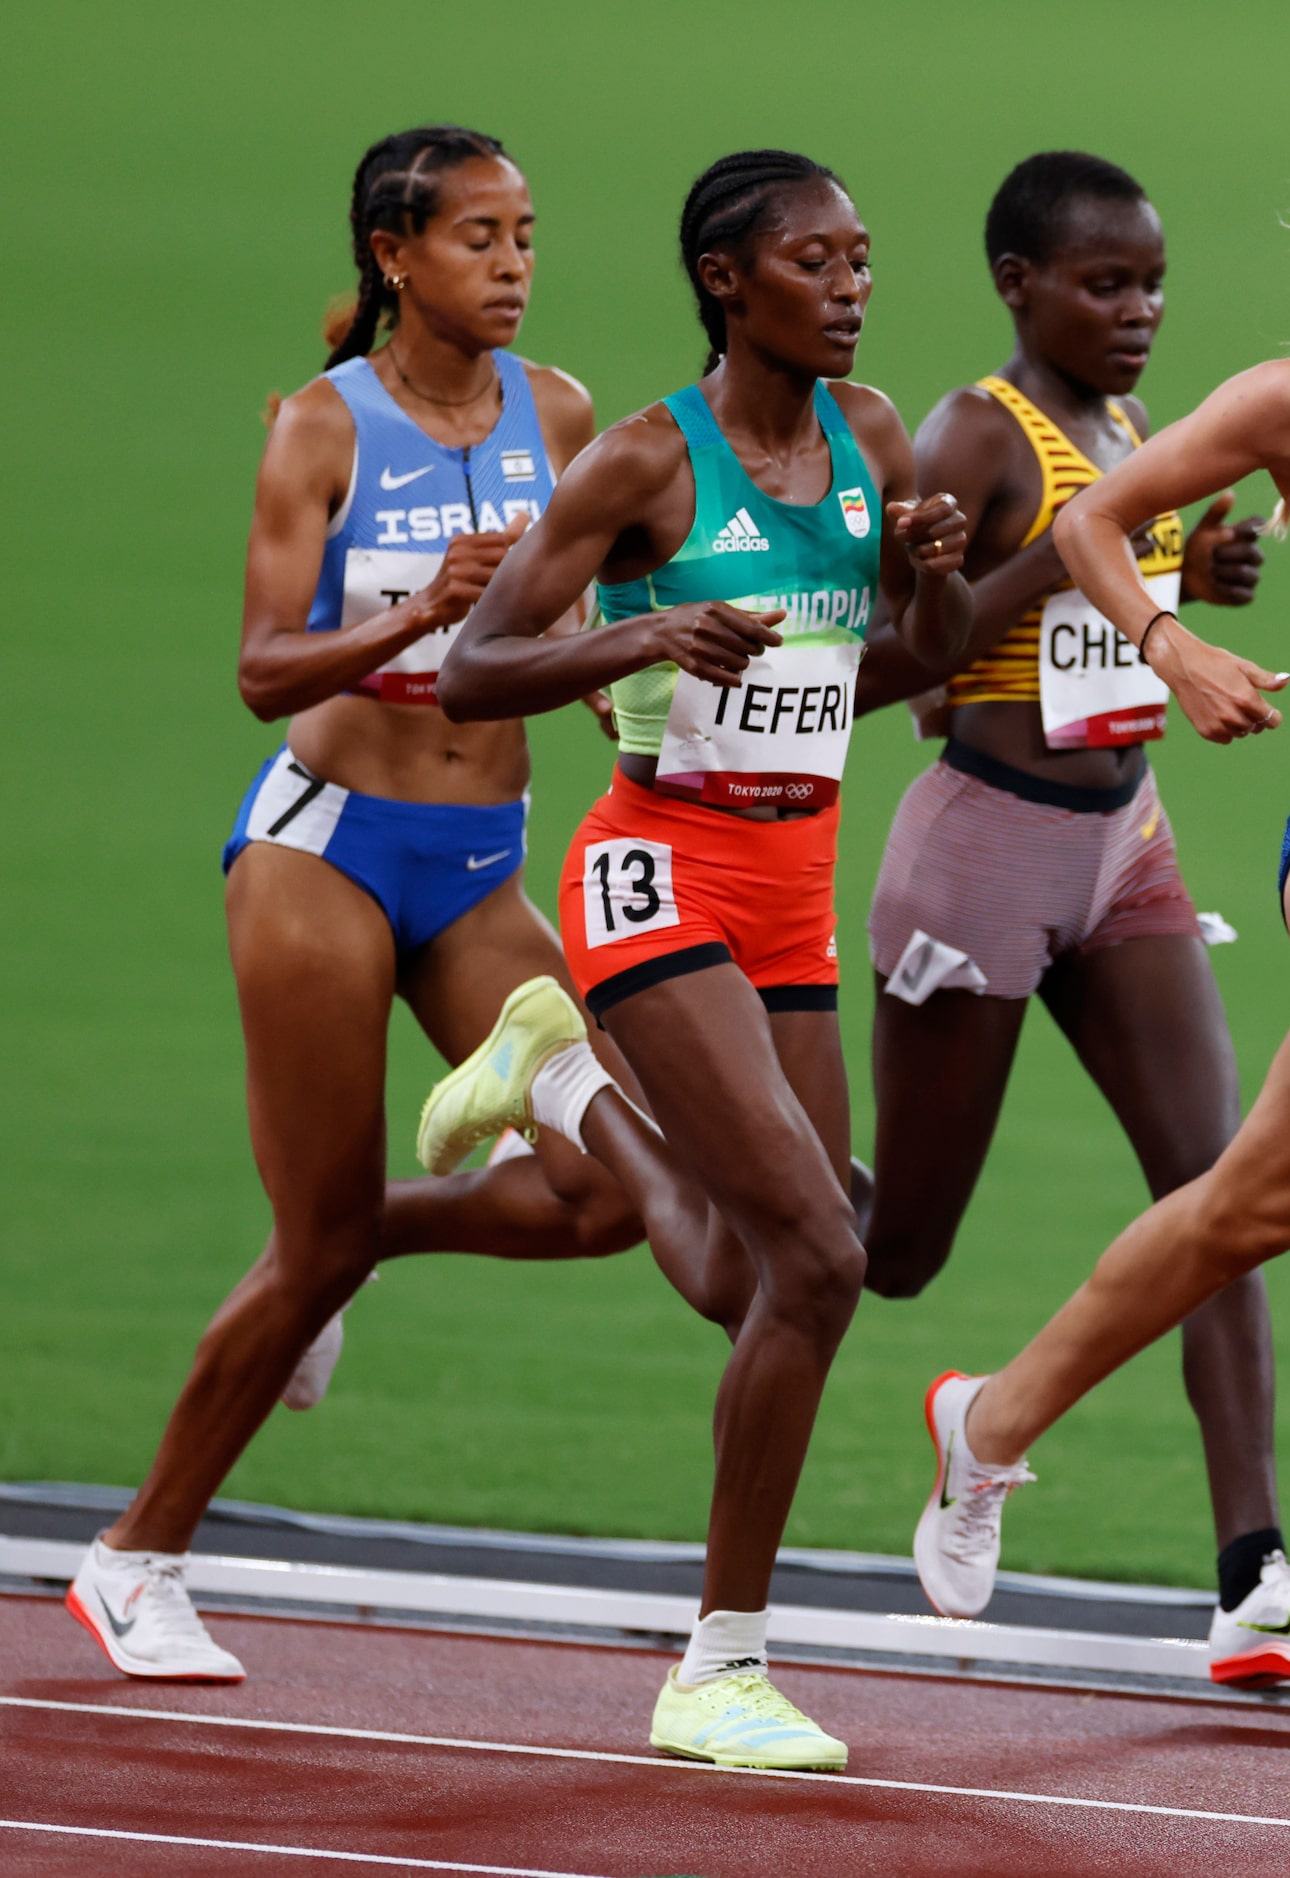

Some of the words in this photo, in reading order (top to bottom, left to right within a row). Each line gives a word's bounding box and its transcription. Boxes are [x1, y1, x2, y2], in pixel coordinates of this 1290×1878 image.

[712, 536, 770, 553] adidas
[1051, 624, 1136, 671] CHE
[712, 682, 848, 734] TEFERI
[266, 763, 326, 837] 7
[728, 783, 761, 797] TOKYO
[761, 786, 783, 797] 2020
[592, 849, 660, 932] 13
